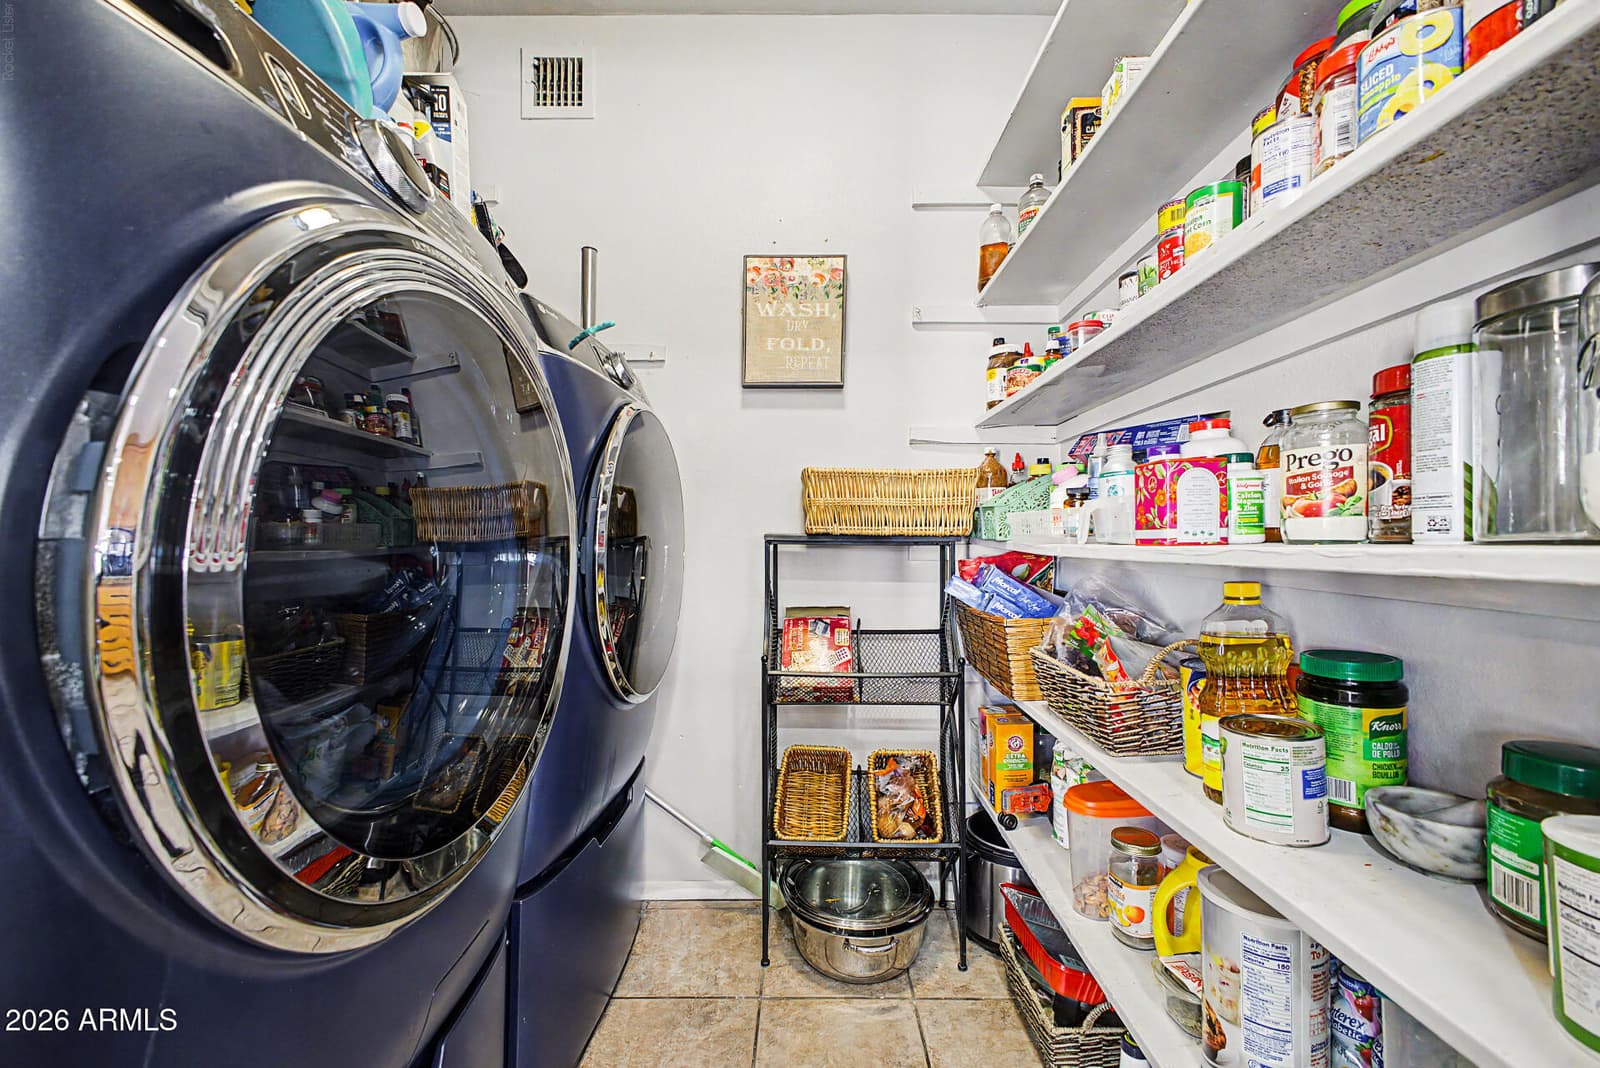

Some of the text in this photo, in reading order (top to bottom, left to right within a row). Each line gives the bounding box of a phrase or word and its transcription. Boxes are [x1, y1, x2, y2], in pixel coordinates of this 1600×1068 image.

[785, 355, 829, 369] REPEAT
[1286, 447, 1353, 472] Prego
[1371, 721, 1402, 732] Knorr
[1242, 742, 1269, 751] Nutrition
[1371, 742, 1393, 751] CALDO
[1371, 750, 1381, 759] DE
[1243, 934, 1288, 951] Nutrition Facts
[1243, 954, 1265, 966] Calories
[1333, 1008, 1366, 1030] terex
[1333, 1022, 1362, 1041] abetic
